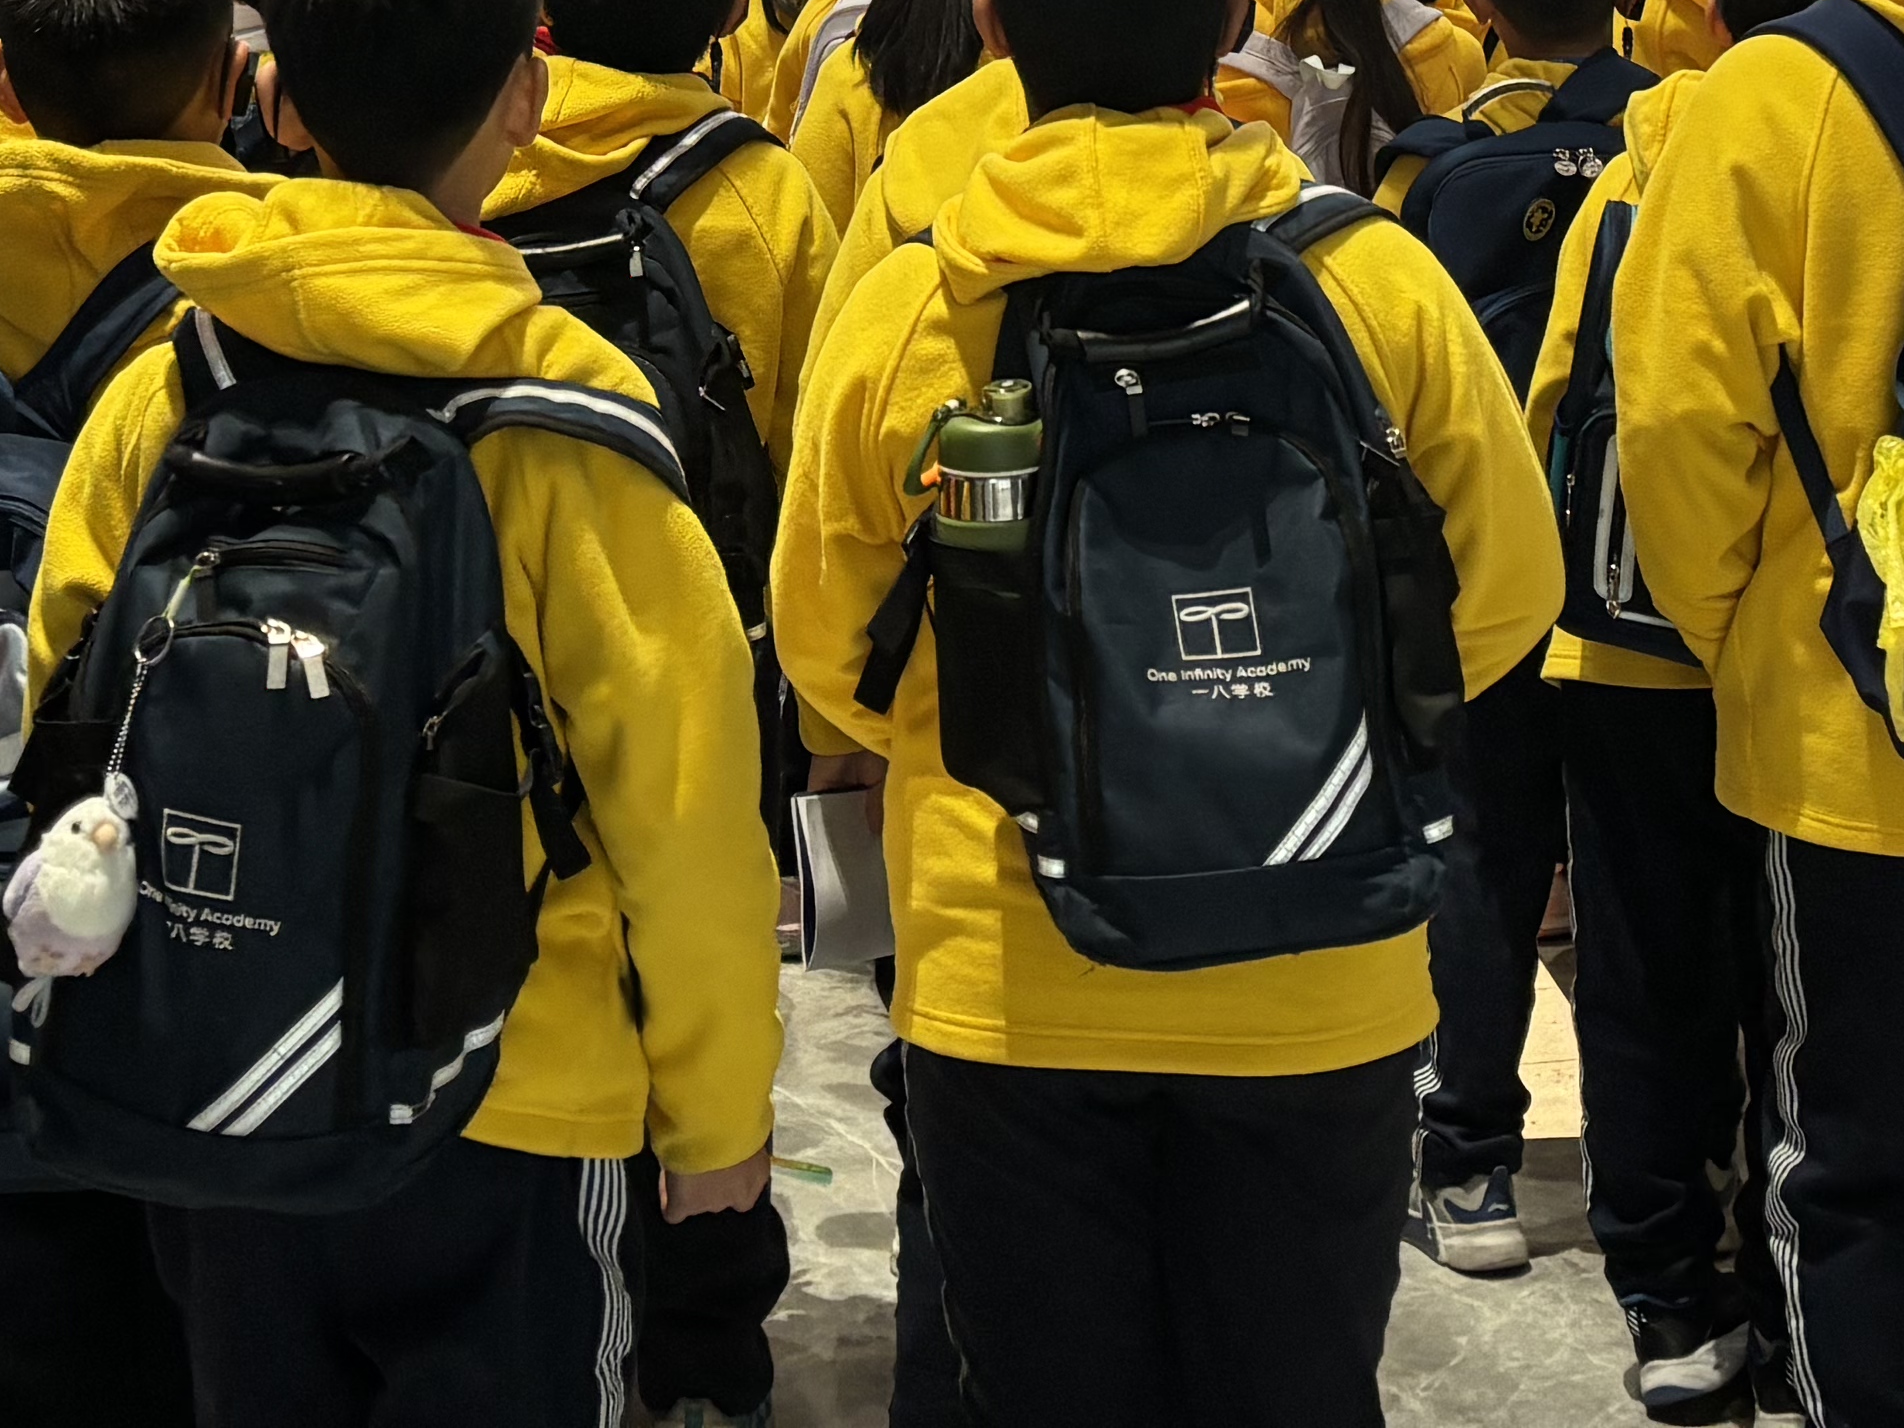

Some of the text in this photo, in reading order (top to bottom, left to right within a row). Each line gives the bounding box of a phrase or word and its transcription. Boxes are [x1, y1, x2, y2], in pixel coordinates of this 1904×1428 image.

[1146, 657, 1311, 682] One Infinity Academy
[1191, 681, 1274, 700] 一八学校
[200, 907, 282, 937] Academy
